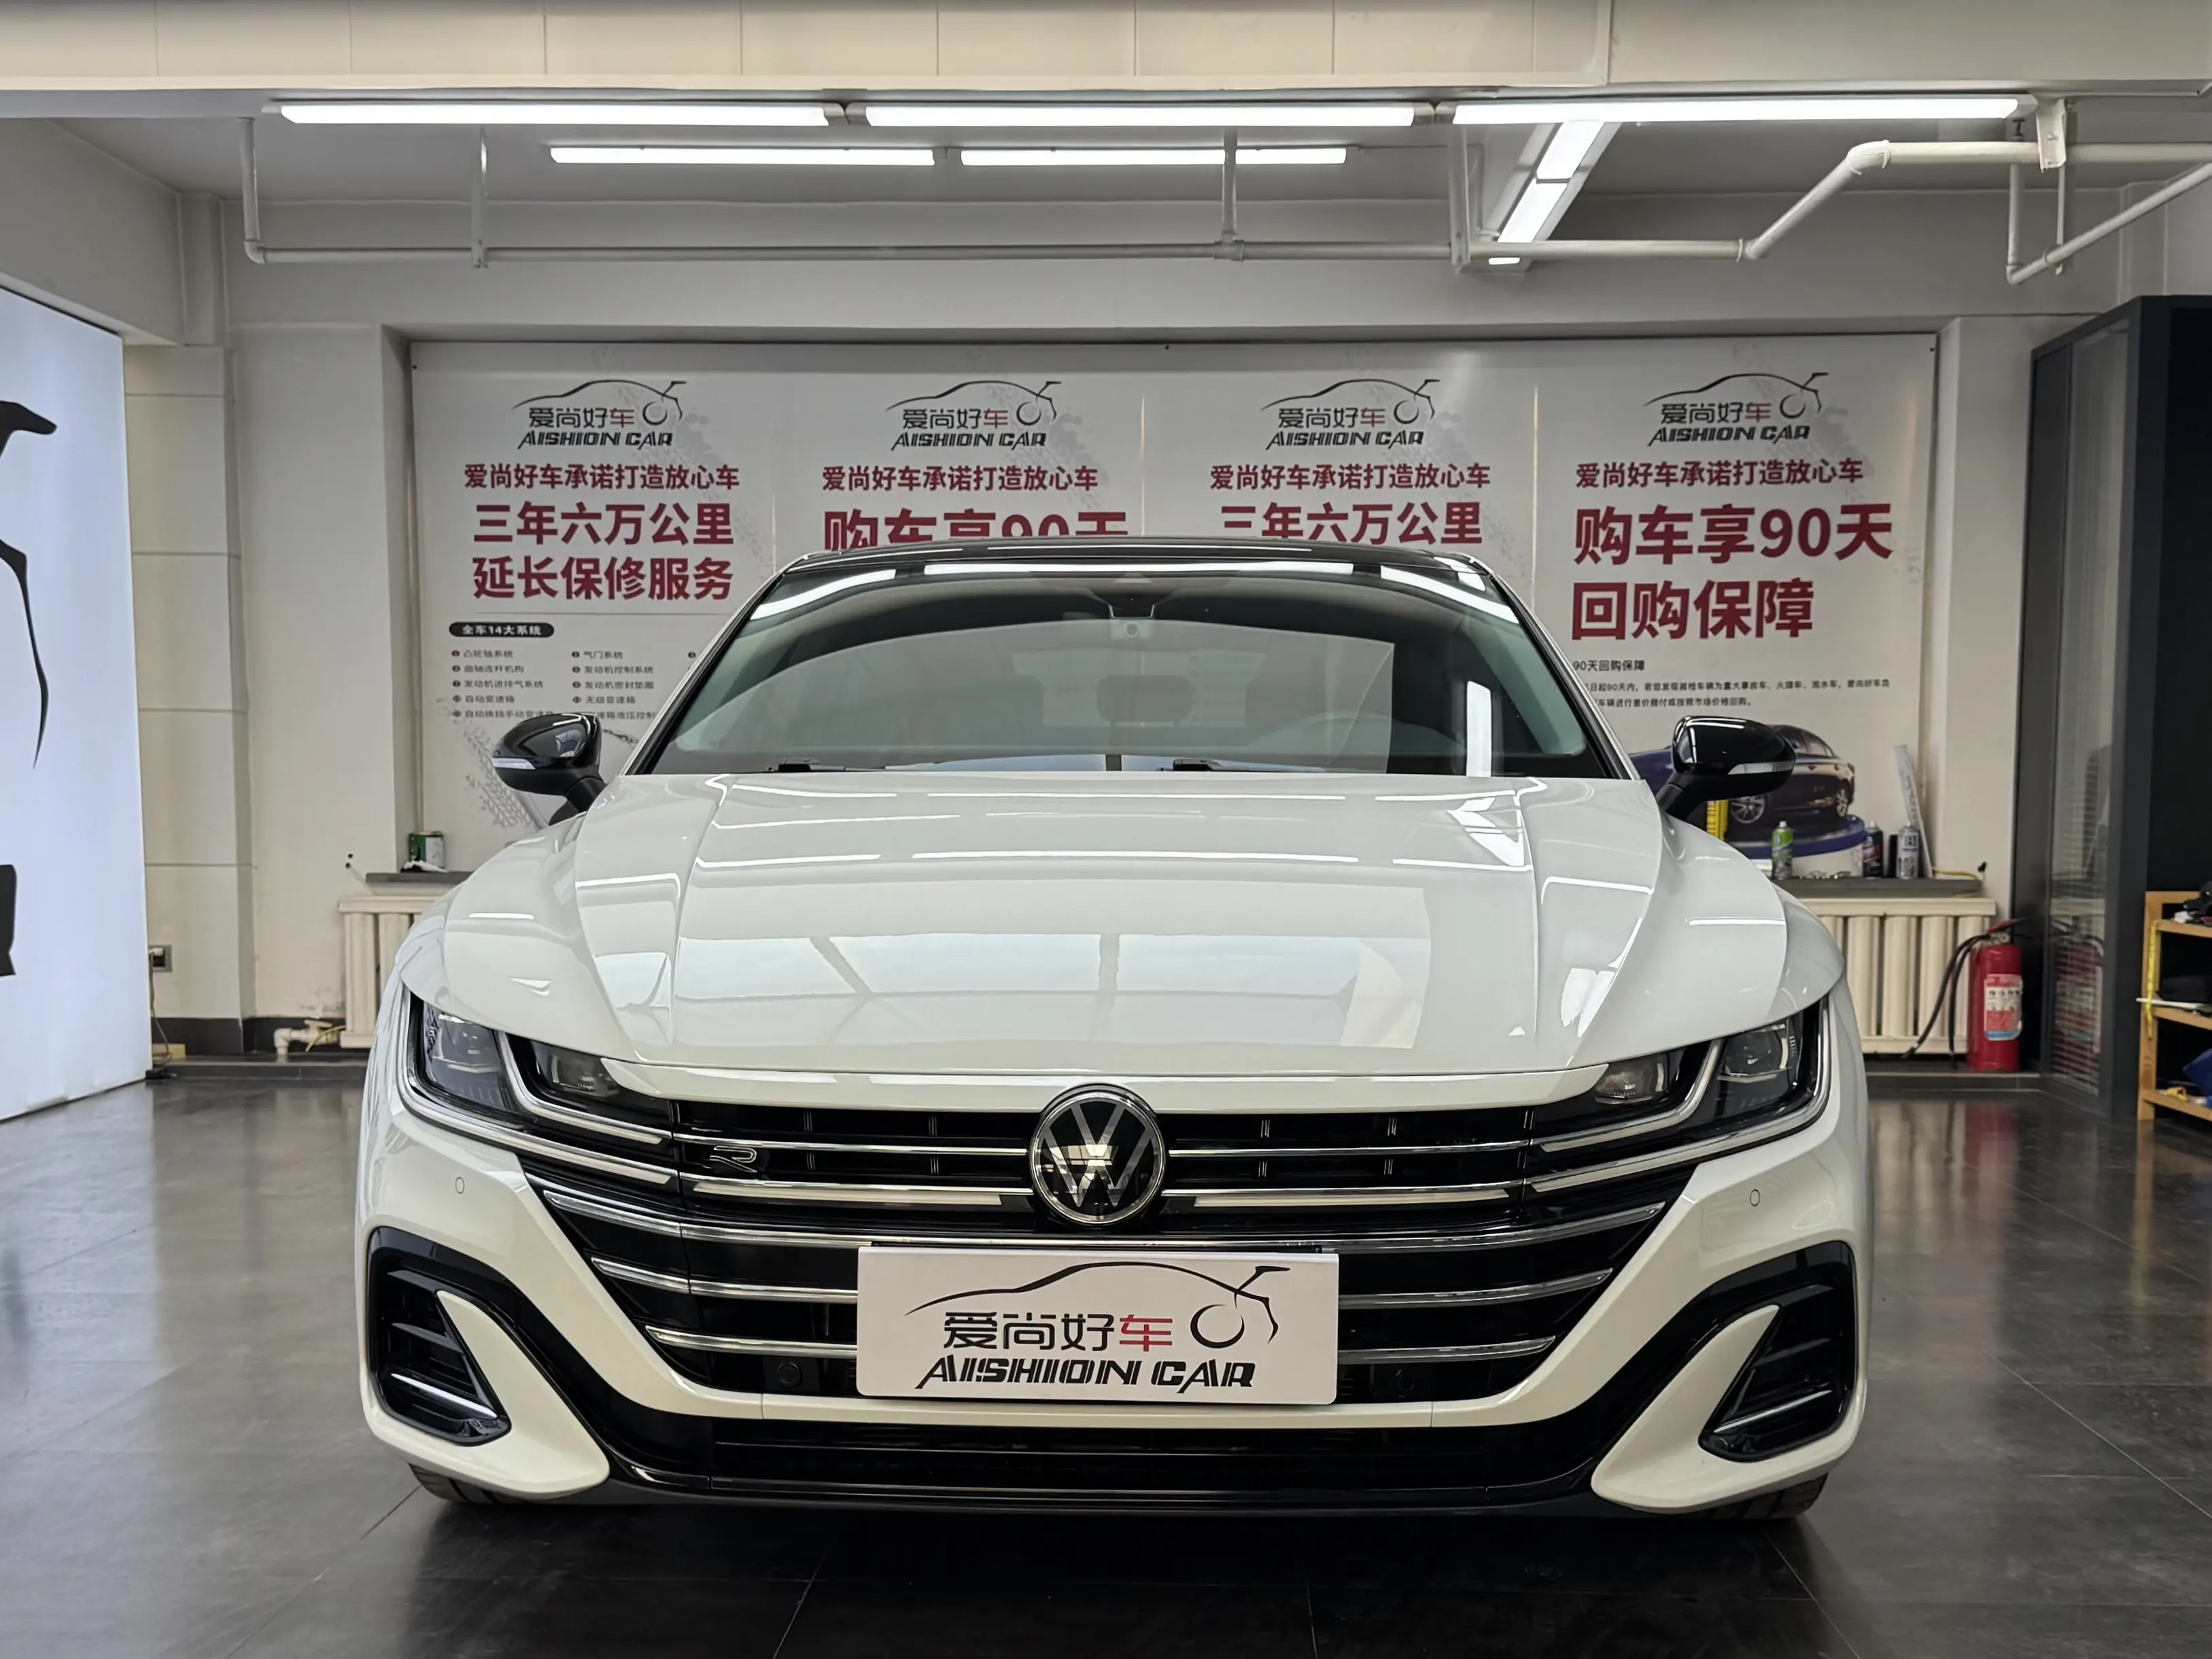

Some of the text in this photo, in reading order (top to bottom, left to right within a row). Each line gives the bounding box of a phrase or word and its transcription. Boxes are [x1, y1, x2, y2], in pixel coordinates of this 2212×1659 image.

[529, 407, 636, 428] 爱尚好车
[903, 408, 1009, 430] 爱尚好车
[1278, 407, 1386, 429] 爱尚好车
[1661, 402, 1772, 424] 爱尚好车
[517, 430, 673, 450] AISHION CAR
[891, 432, 1047, 451] AISHION CAR
[1266, 430, 1425, 450] AISHION CAR
[1647, 425, 1811, 447] AISHION CAR
[464, 464, 740, 491] 爱尚好车承诺打造放心车
[822, 465, 1099, 491] 爱尚好车承诺打造放心车
[1210, 463, 1491, 490] 爱尚好车承诺打造放心车
[1575, 458, 1864, 489] 爱尚好车承诺打造放心车
[474, 501, 734, 546] 三年六万公里
[1574, 503, 1893, 565] 购车享90天
[472, 555, 733, 600] 延长保修服务
[1572, 577, 1814, 641] 回购保障
[462, 625, 542, 635] 全车14大系统
[1572, 659, 1645, 672] 90天回购保障
[943, 1310, 1174, 1352] 爱尚好车
[914, 1354, 1257, 1394] AISHION CAR
